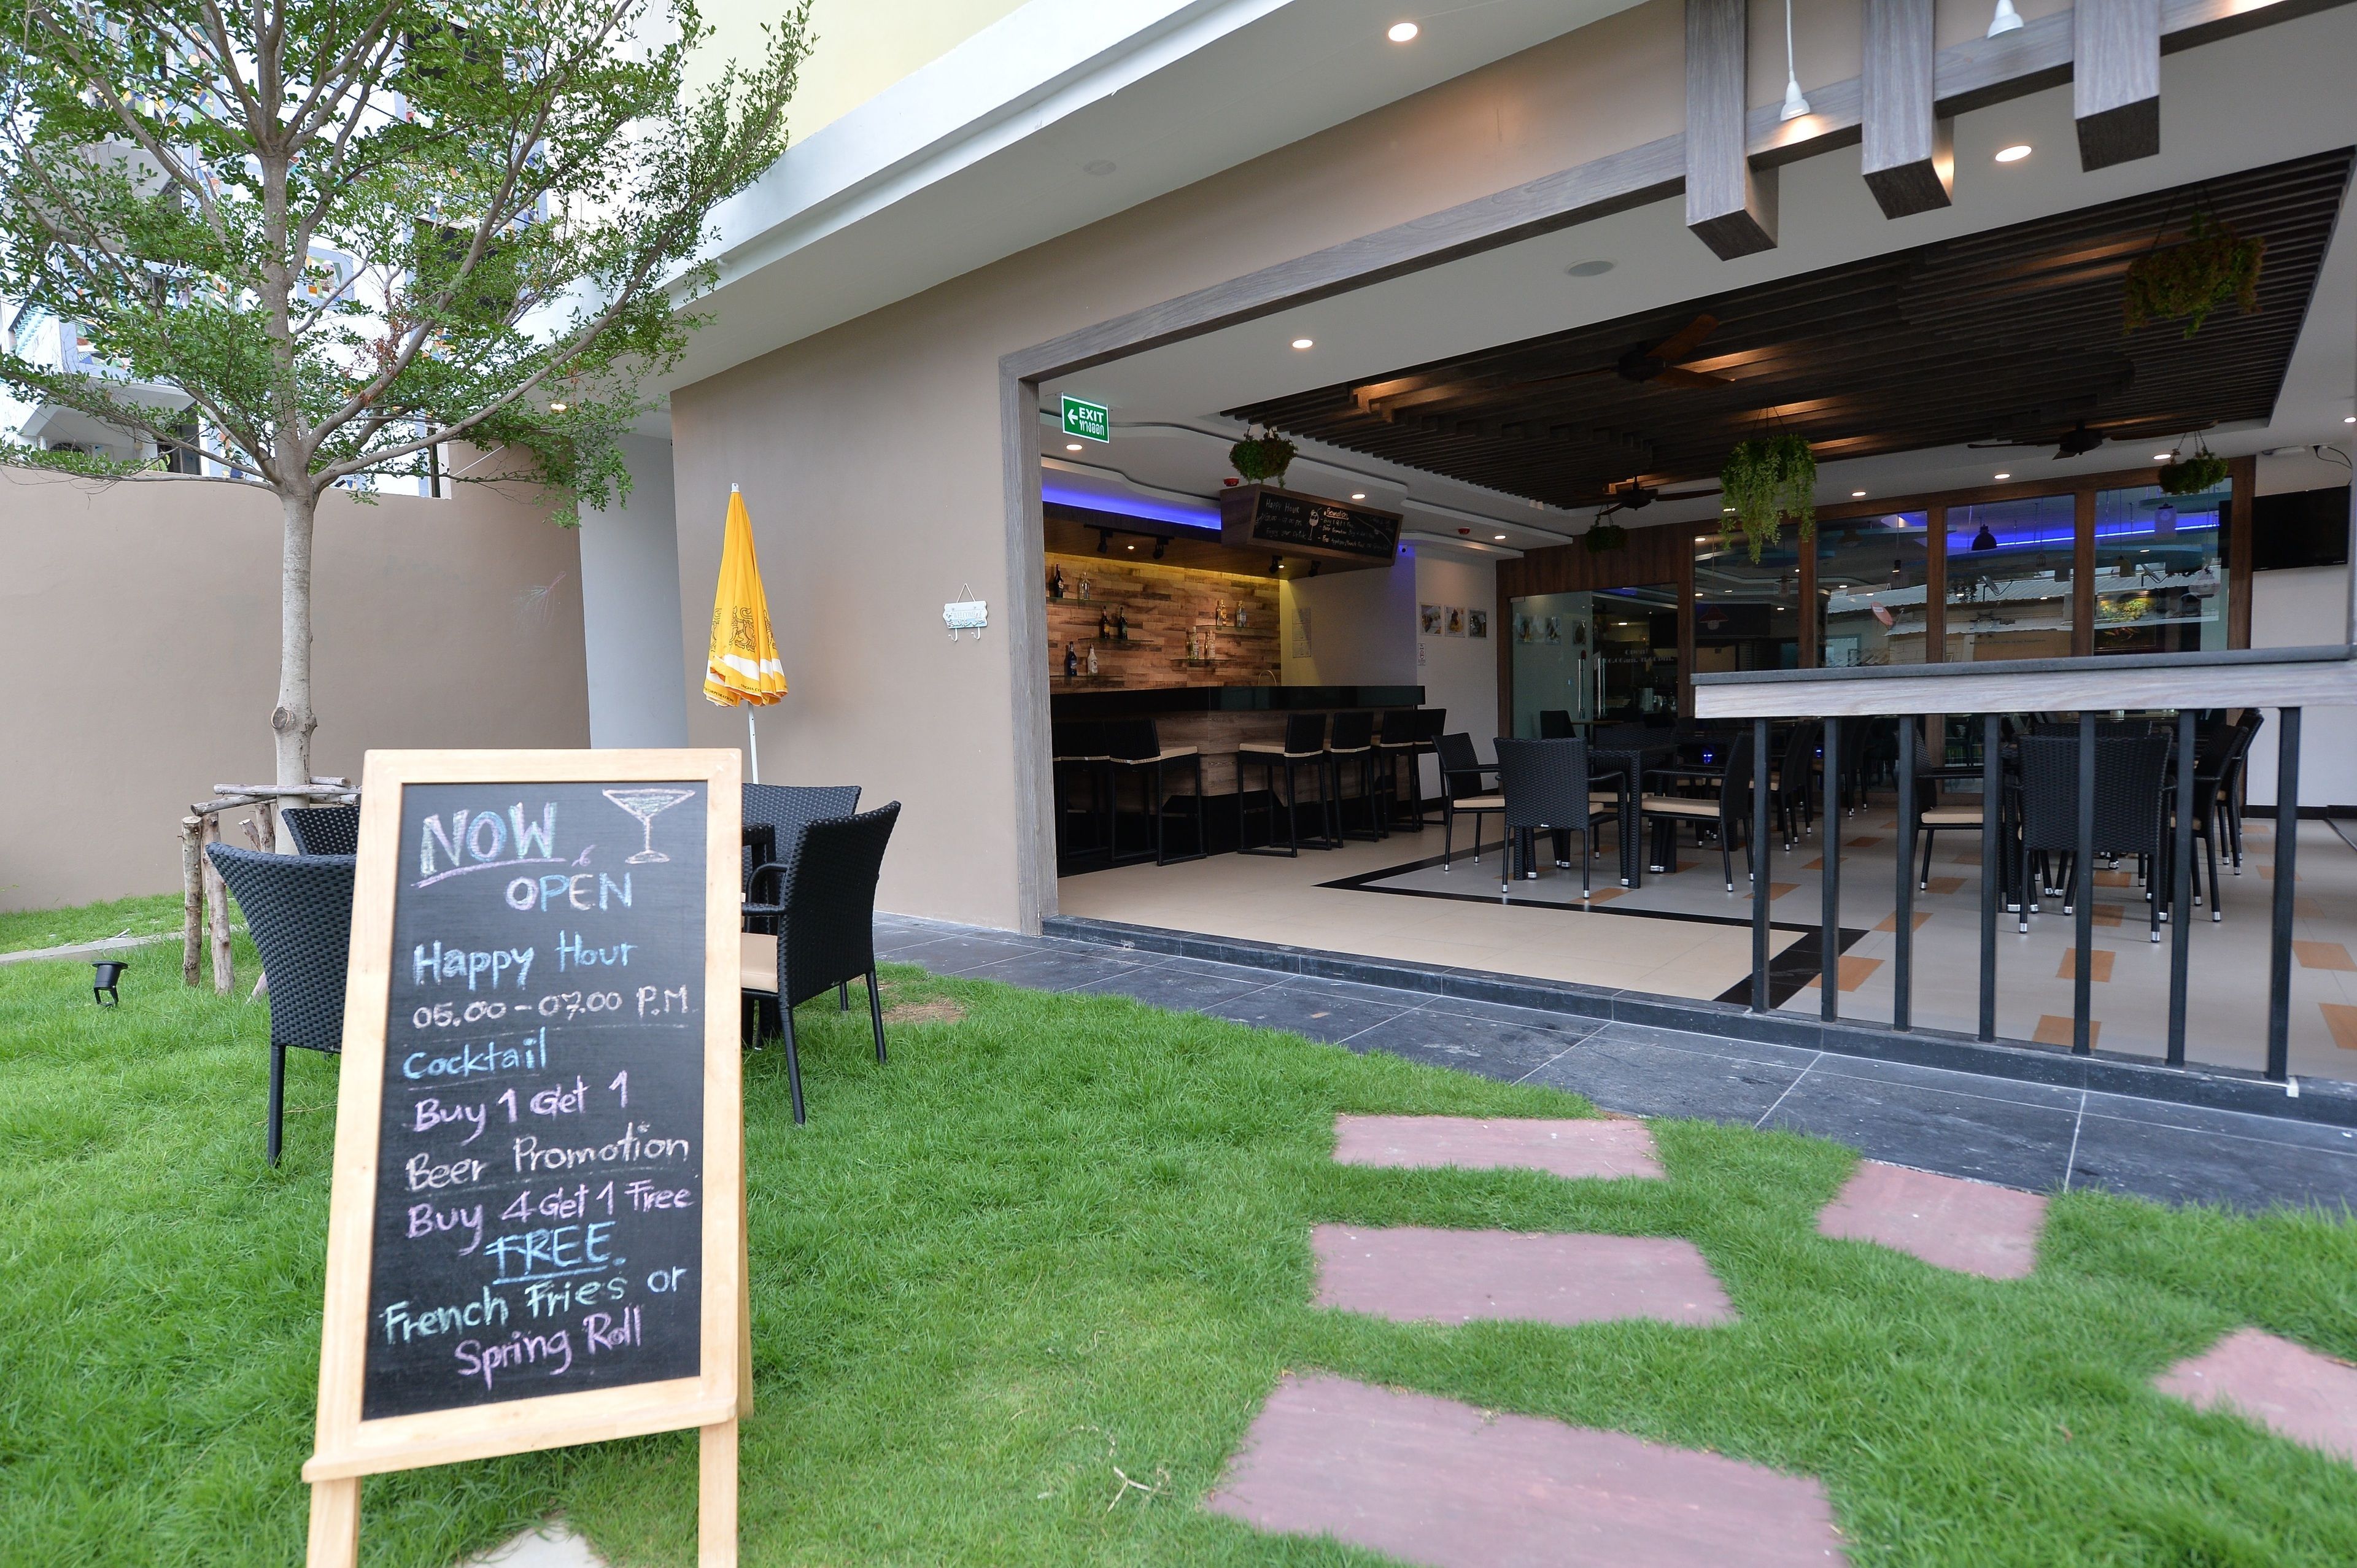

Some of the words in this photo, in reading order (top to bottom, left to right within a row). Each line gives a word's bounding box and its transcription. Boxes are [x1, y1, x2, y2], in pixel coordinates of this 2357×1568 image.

[1079, 407, 1104, 423] EXIT
[1079, 420, 1104, 436] ทางออก
[420, 801, 557, 878] NOW
[506, 873, 632, 912] OPEN
[414, 940, 534, 992] Happy
[555, 930, 638, 972] Hour
[403, 1025, 547, 1079] Cocktail
[414, 1098, 486, 1146] Buy
[498, 1088, 517, 1122] 1
[530, 1075, 590, 1115] Get
[608, 1070, 629, 1108] 1
[406, 1153, 487, 1192] Beer
[513, 1121, 689, 1172] Promotion
[406, 1203, 484, 1257] Buy
[501, 1190, 533, 1222] 4
[540, 1185, 588, 1219] Get
[597, 1181, 614, 1215] 1
[625, 1179, 695, 1212] Free
[379, 1286, 509, 1345] French
[524, 1275, 629, 1318] Fries
[647, 1266, 688, 1293] or
[454, 1331, 571, 1390] Spring
[582, 1305, 642, 1356] Roll
